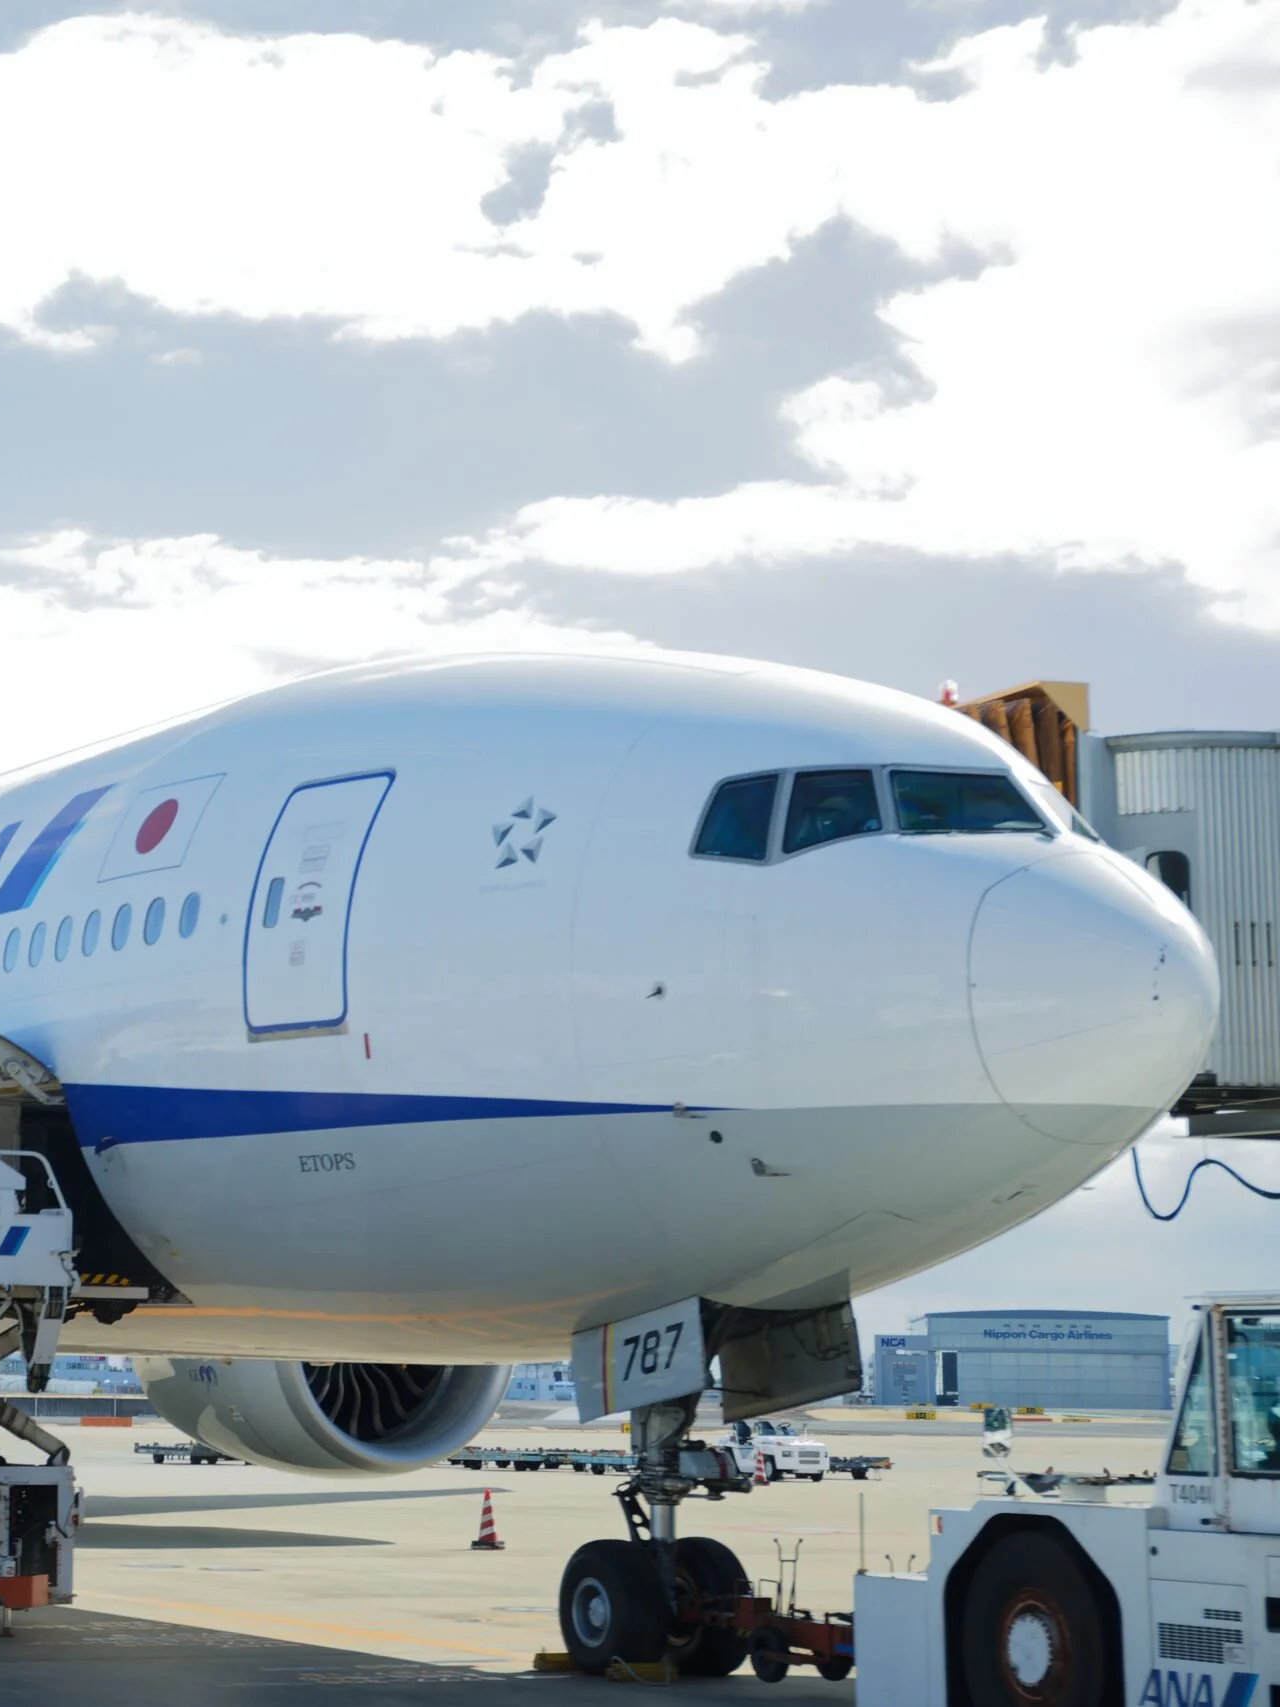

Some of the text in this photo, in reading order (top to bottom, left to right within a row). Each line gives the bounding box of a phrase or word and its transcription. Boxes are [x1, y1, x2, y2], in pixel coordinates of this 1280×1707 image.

[298, 1152, 356, 1173] ETOPS
[880, 1337, 906, 1348] NCA
[983, 1328, 1113, 1341] Nippon Cargo Airlines
[623, 1321, 685, 1382] 787
[1138, 1668, 1217, 1707] ANA
